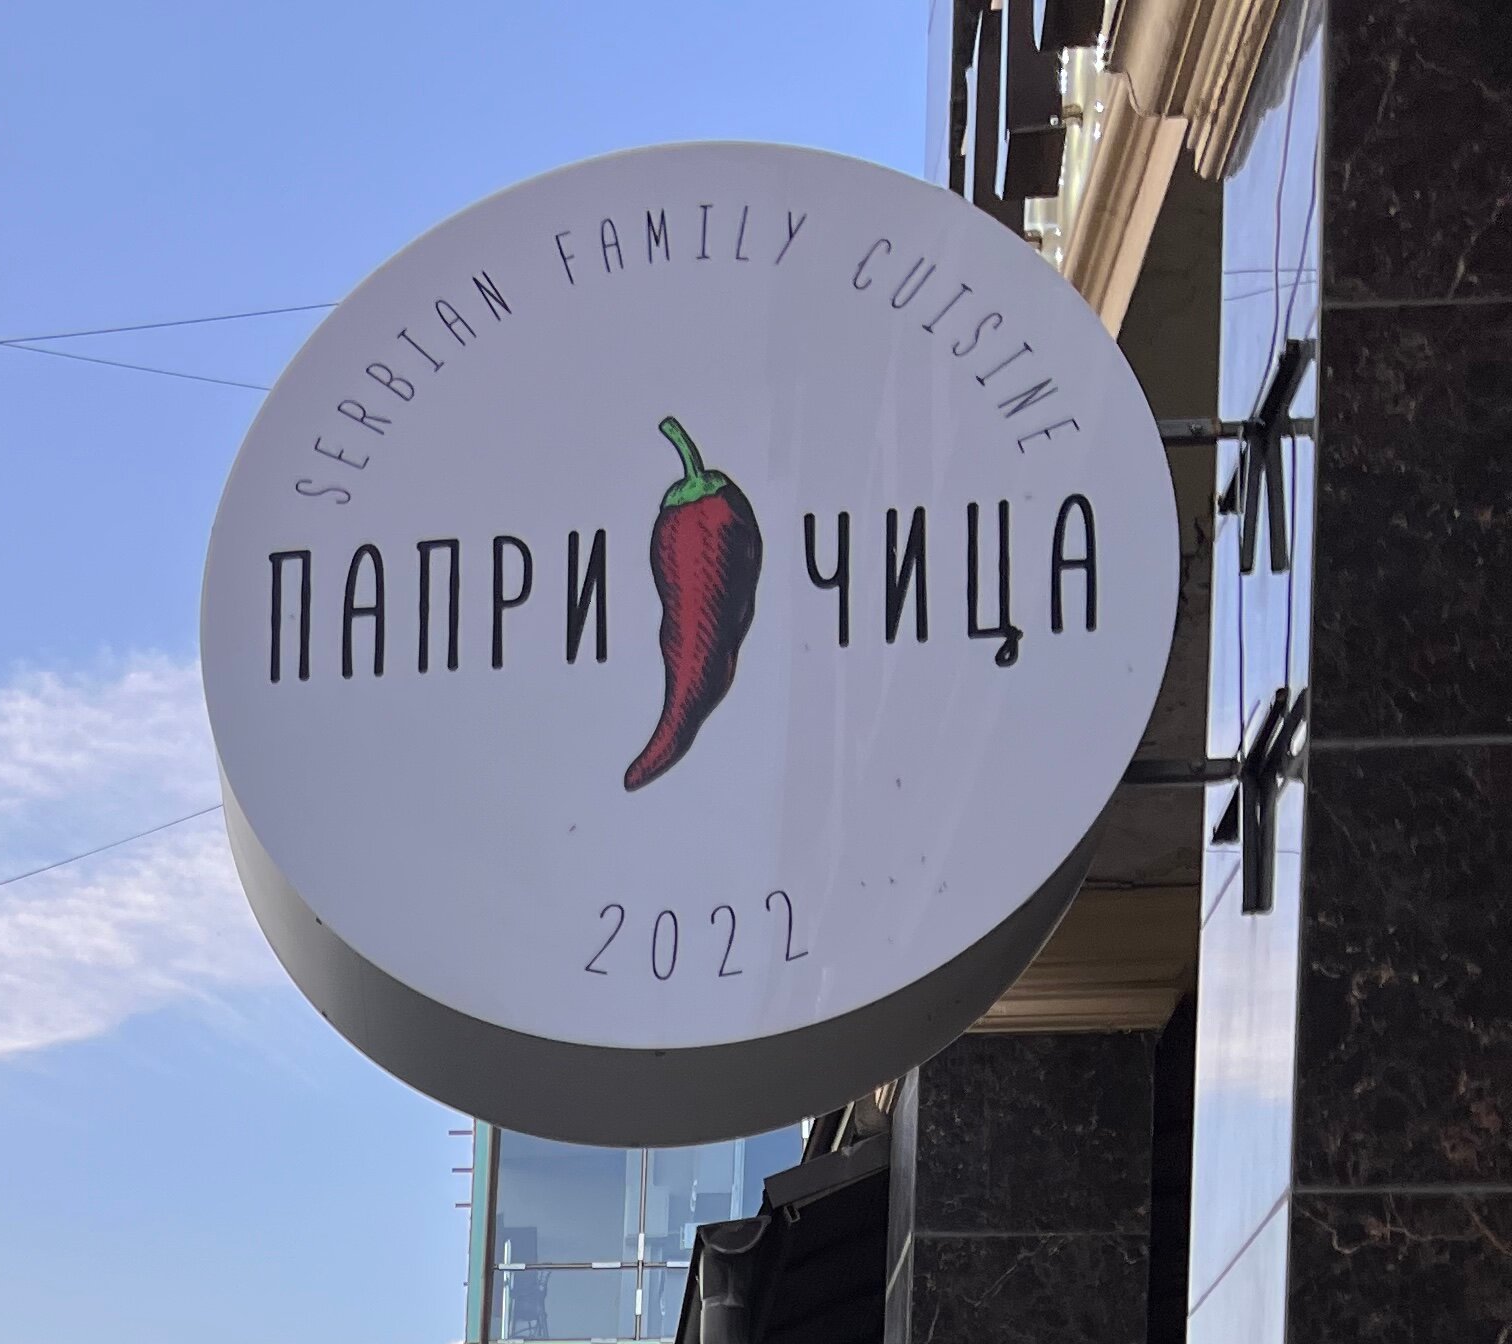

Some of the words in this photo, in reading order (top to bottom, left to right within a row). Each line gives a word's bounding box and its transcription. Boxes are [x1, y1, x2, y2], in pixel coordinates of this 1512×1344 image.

[295, 269, 515, 506] SERBIAN
[554, 203, 808, 286] FAMILY
[853, 237, 1081, 455] CUISINE
[585, 889, 810, 981] 2022
